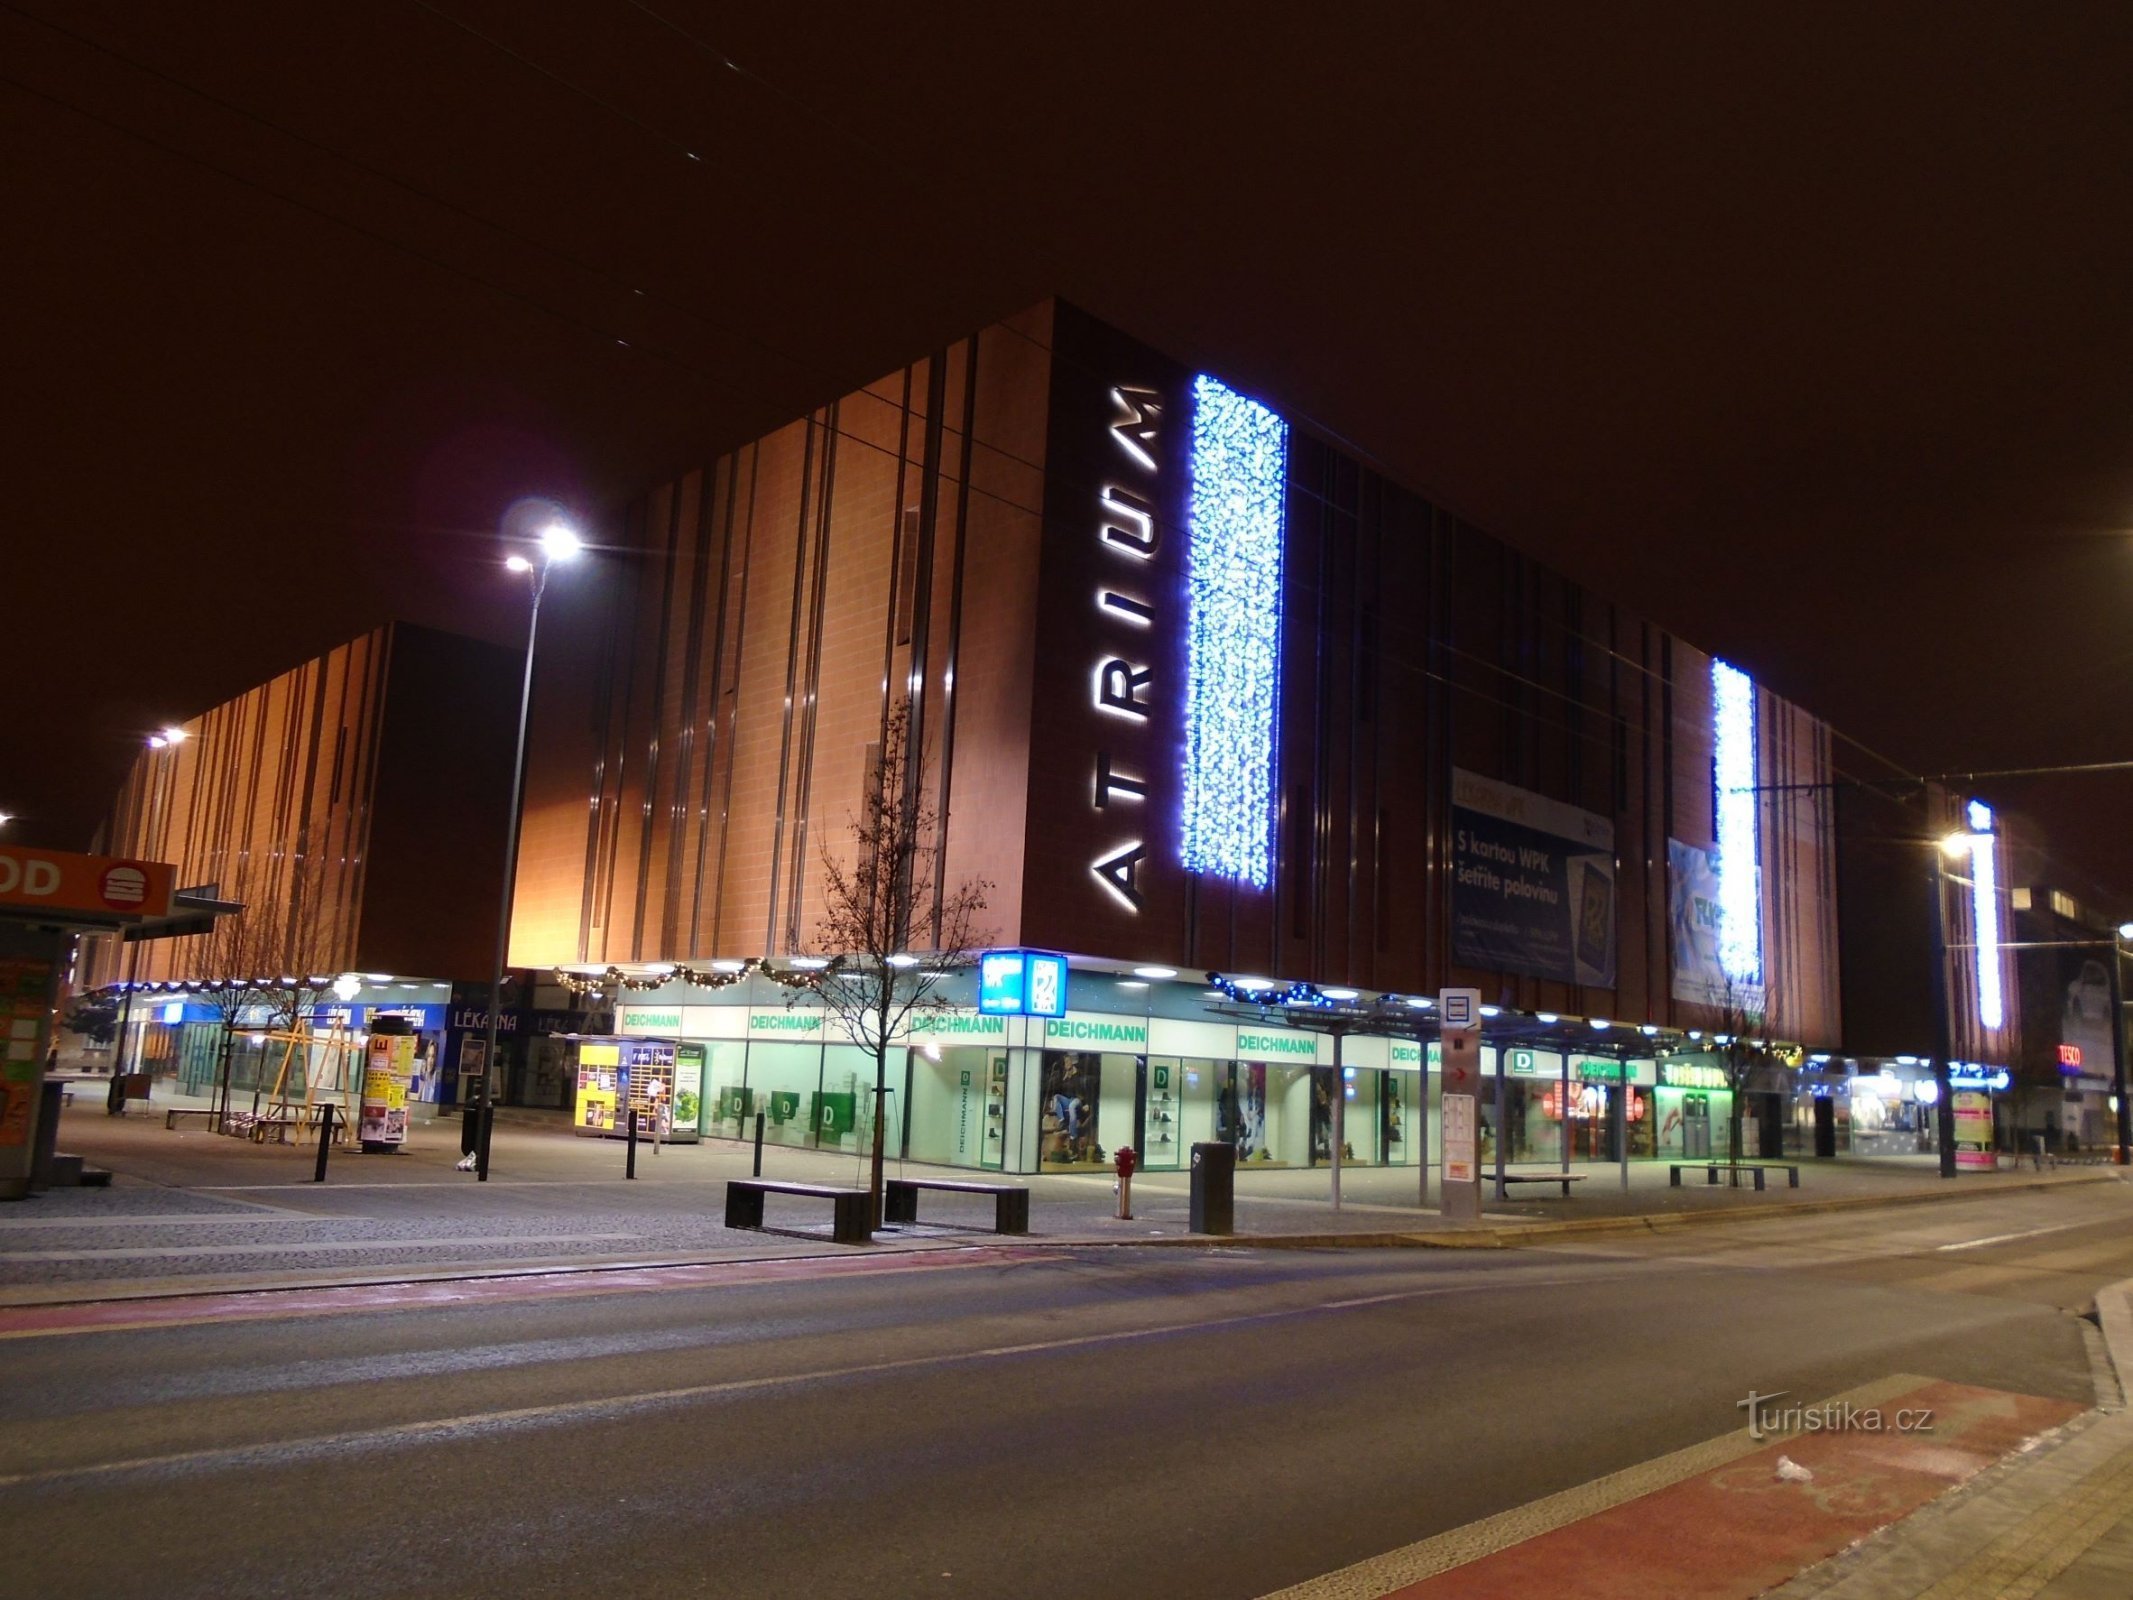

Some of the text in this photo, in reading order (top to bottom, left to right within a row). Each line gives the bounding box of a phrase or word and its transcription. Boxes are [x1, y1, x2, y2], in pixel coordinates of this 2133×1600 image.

[1091, 385, 1163, 914] ATRIUM
[1457, 830, 1550, 873] S kartou WPK
[1504, 874, 1558, 905] polovinu
[624, 1014, 680, 1028] DEICHMANN
[751, 1015, 821, 1031] DEICHMANN
[912, 1016, 1004, 1034] DEICHMANN
[1046, 1020, 1146, 1043] DEICHMANN
[1238, 1034, 1315, 1055] DEICHMANN
[1516, 1052, 1532, 1068] D
[2058, 1045, 2081, 1067] TESCO
[1156, 1069, 1167, 1085] D
[733, 1097, 744, 1113] D
[782, 1101, 791, 1114] D
[823, 1106, 835, 1126] D
[959, 1087, 969, 1153] DEICHMANN
